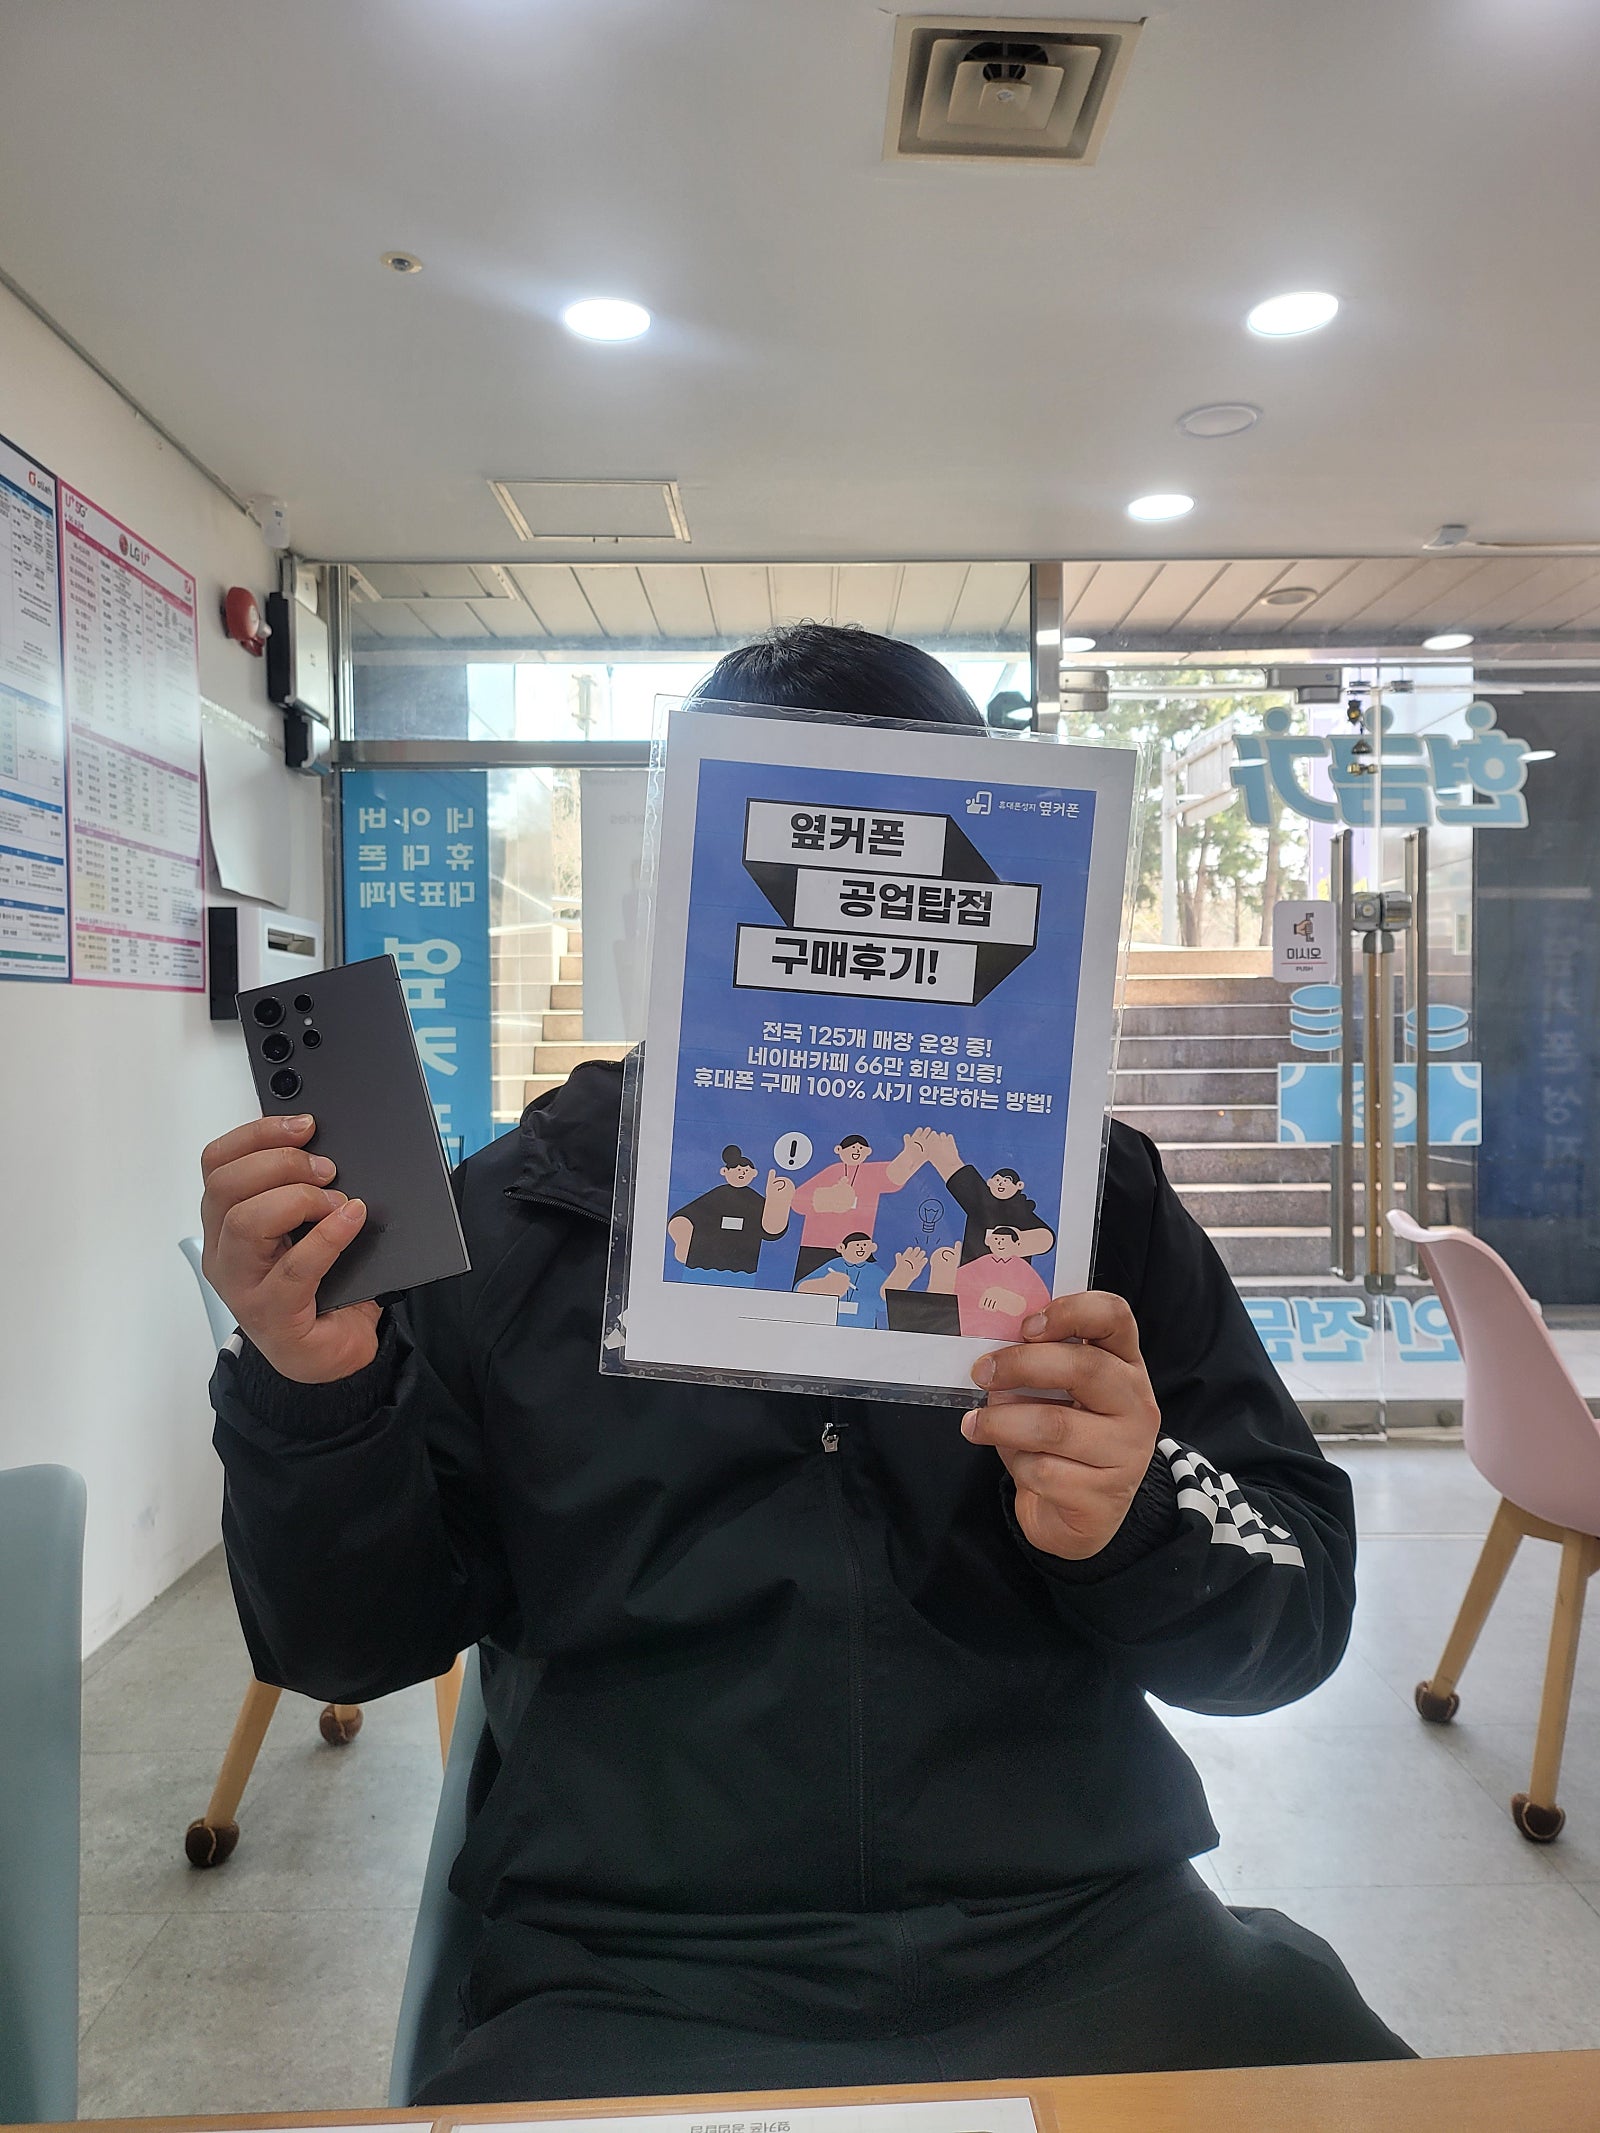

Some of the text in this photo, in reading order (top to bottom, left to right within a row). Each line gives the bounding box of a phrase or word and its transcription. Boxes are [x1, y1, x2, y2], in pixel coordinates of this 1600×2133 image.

[129, 543, 140, 563] LG
[1039, 801, 1081, 819] 옆커폰
[790, 813, 905, 857] 옆커폰
[839, 879, 993, 927] 공업탑점
[771, 937, 939, 985] 구매후기!
[1286, 947, 1322, 960] 미시오
[762, 1020, 993, 1058] 전국 125개 매장 운영 중!
[747, 1046, 1003, 1084] 네이버카페 66만 회원 인증!
[693, 1067, 1053, 1114] 휴대폰 구매 100% 사기 안당하는 방법!
